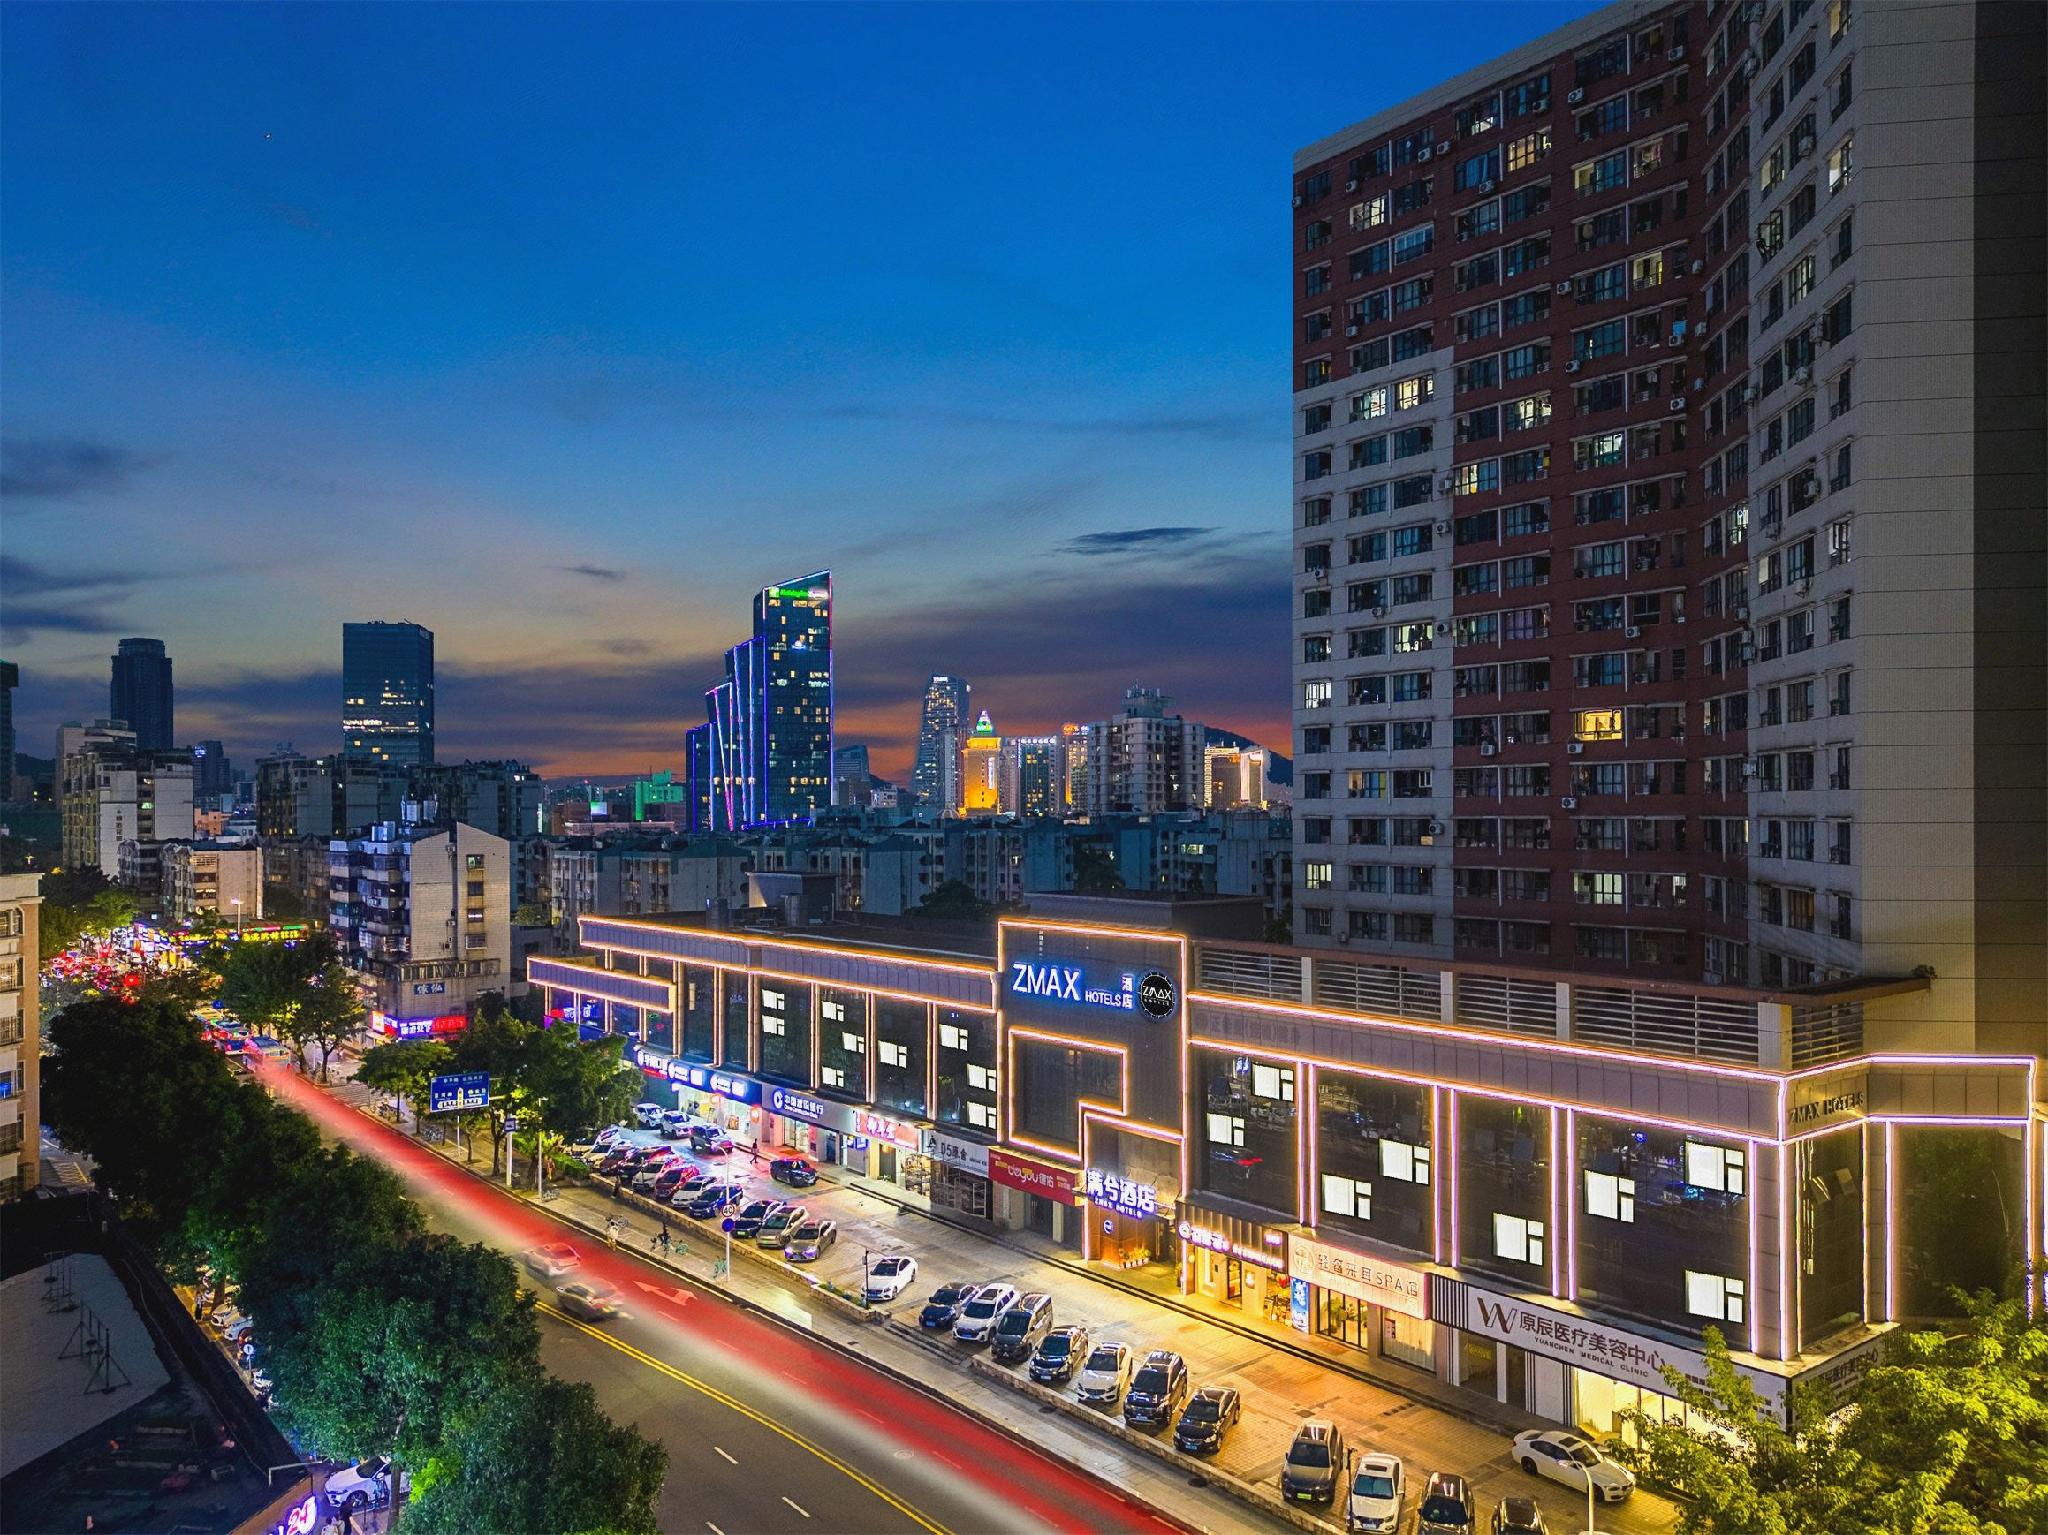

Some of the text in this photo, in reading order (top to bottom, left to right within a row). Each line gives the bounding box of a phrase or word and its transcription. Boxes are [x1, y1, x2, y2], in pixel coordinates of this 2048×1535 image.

[1012, 963, 1122, 1007] ZMAX HOTELS
[1121, 976, 1133, 1009] 酒店
[1142, 985, 1172, 1001] ZMAX
[1790, 1092, 1865, 1124] ZMAX HOTELS
[723, 1206, 733, 1214] 40
[1519, 1310, 1667, 1371] 原辰医疗美容中心
[1534, 1336, 1649, 1377] YUANCHEN MEDICAL CLINIC
